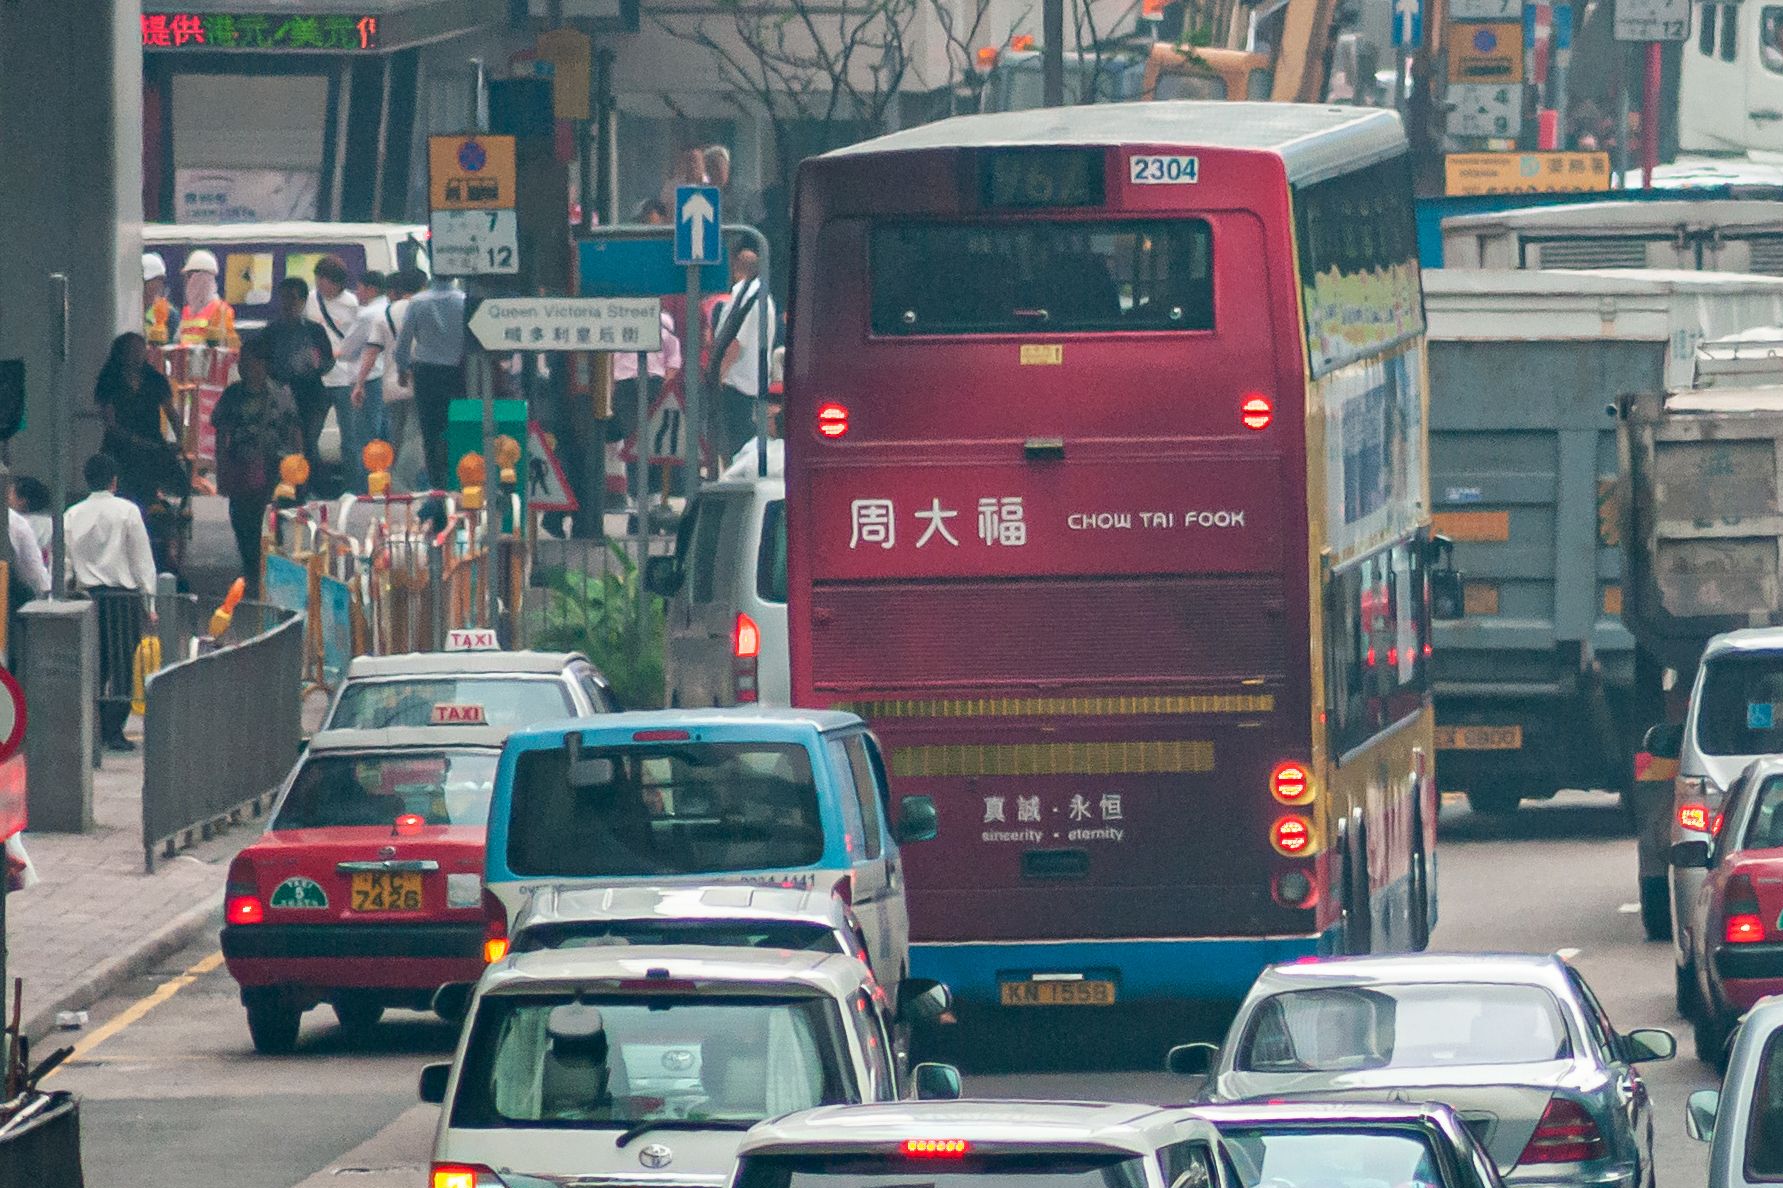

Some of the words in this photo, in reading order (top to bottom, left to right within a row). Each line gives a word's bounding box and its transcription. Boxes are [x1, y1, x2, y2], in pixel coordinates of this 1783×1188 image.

[1134, 158, 1197, 181] 2304
[487, 246, 512, 268] 12
[488, 304, 538, 319] Queen
[544, 304, 601, 319] Victoria
[607, 304, 656, 318] Street
[849, 497, 1027, 549] 周大福
[1066, 511, 1131, 528] CHOW
[1139, 511, 1174, 527] TAI
[1184, 509, 1245, 527] FOOK
[451, 632, 493, 648] TAXI
[435, 706, 481, 721] TAXI
[981, 831, 1044, 843] sincerity
[1067, 829, 1124, 843] eternity
